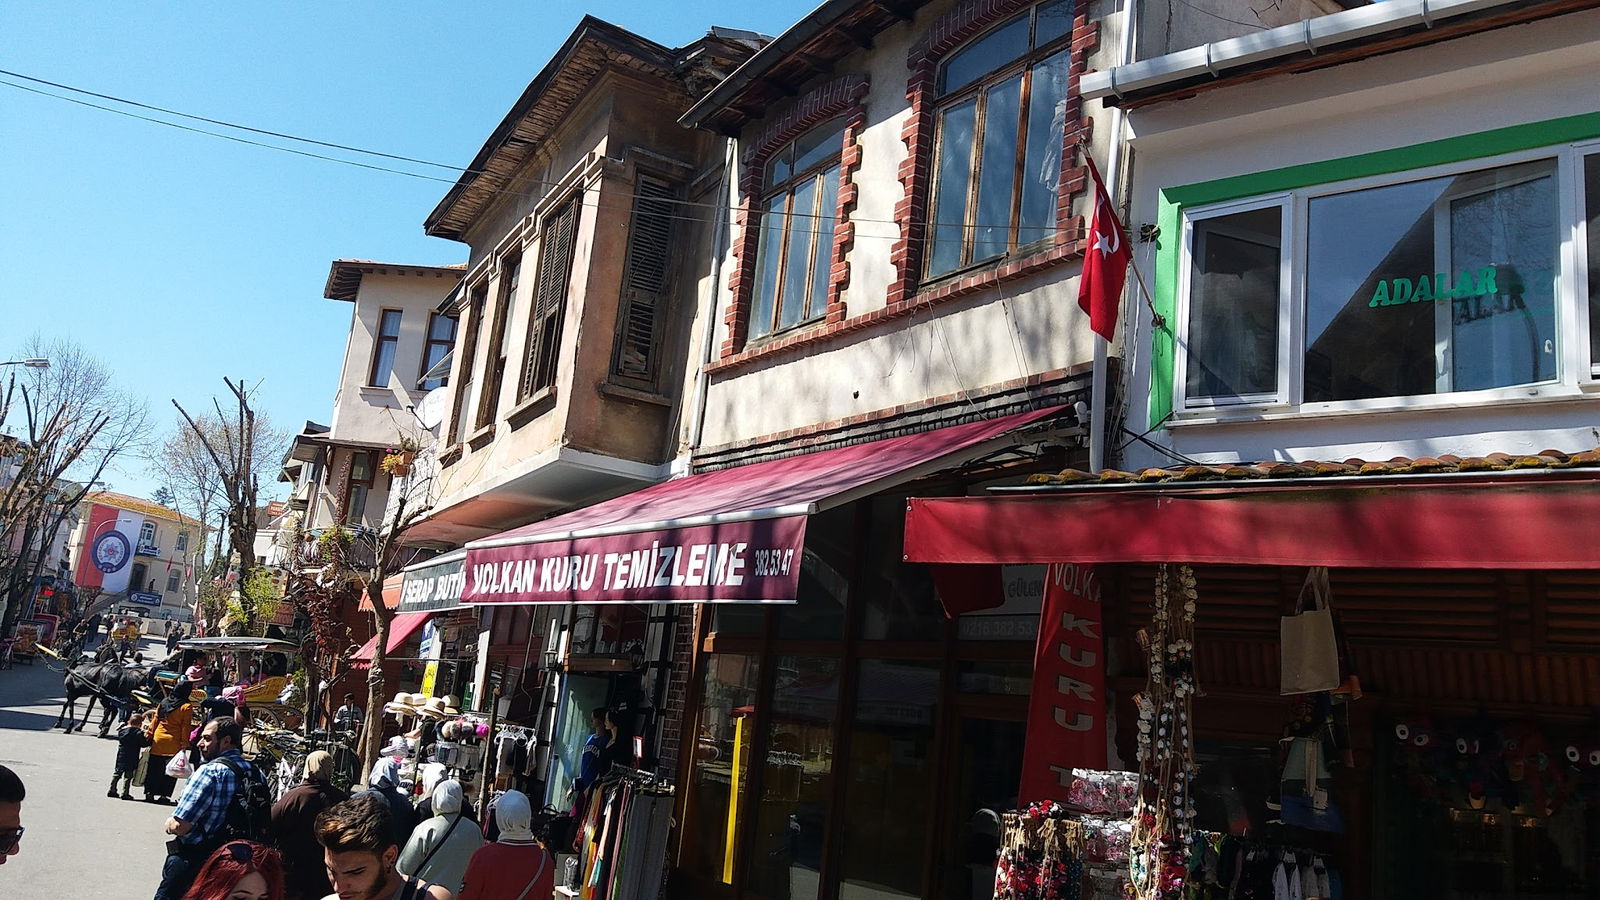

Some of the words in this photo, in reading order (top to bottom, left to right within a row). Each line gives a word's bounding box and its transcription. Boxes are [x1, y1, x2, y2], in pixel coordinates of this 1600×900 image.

[1369, 266, 1498, 308] ADALAR
[405, 577, 434, 603] SERAP
[469, 559, 536, 597] VOLKAN
[539, 554, 599, 592] KURU
[603, 540, 747, 590] TEMİZLEME
[755, 551, 770, 576] 382
[769, 551, 781, 575] 53
[781, 549, 794, 576] 47
[1054, 612, 1100, 731] KURU
